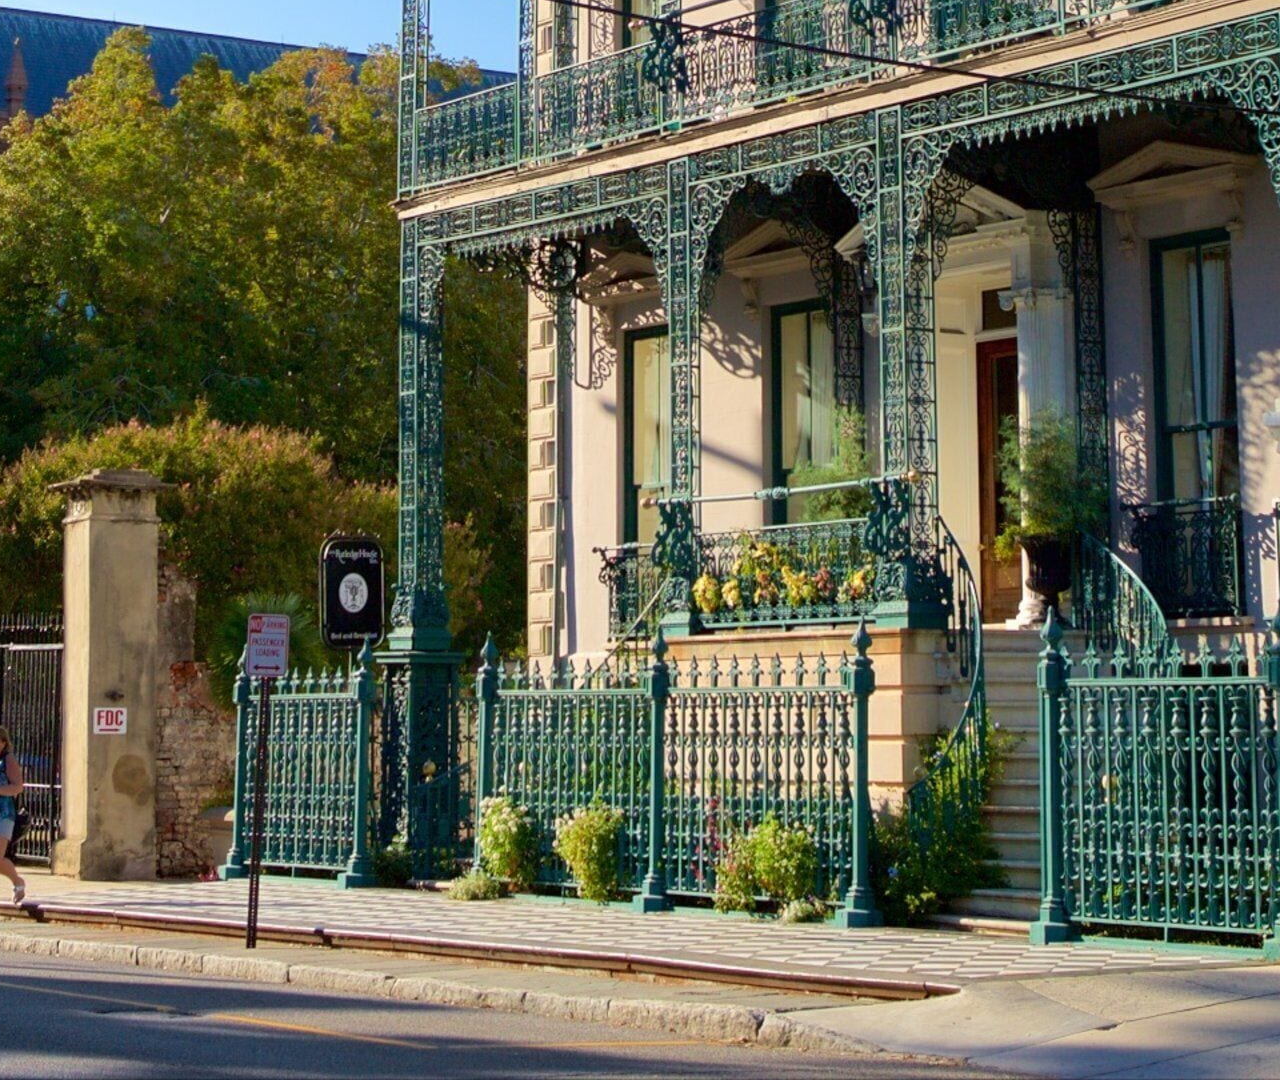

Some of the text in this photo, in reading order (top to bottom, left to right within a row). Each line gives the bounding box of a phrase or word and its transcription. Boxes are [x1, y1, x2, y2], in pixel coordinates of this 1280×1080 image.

[250, 618, 287, 631] NO PARKING
[330, 632, 342, 640] Bed
[251, 637, 285, 648] PASSENGER
[255, 648, 281, 658] LOADING
[97, 710, 124, 726] FDC
